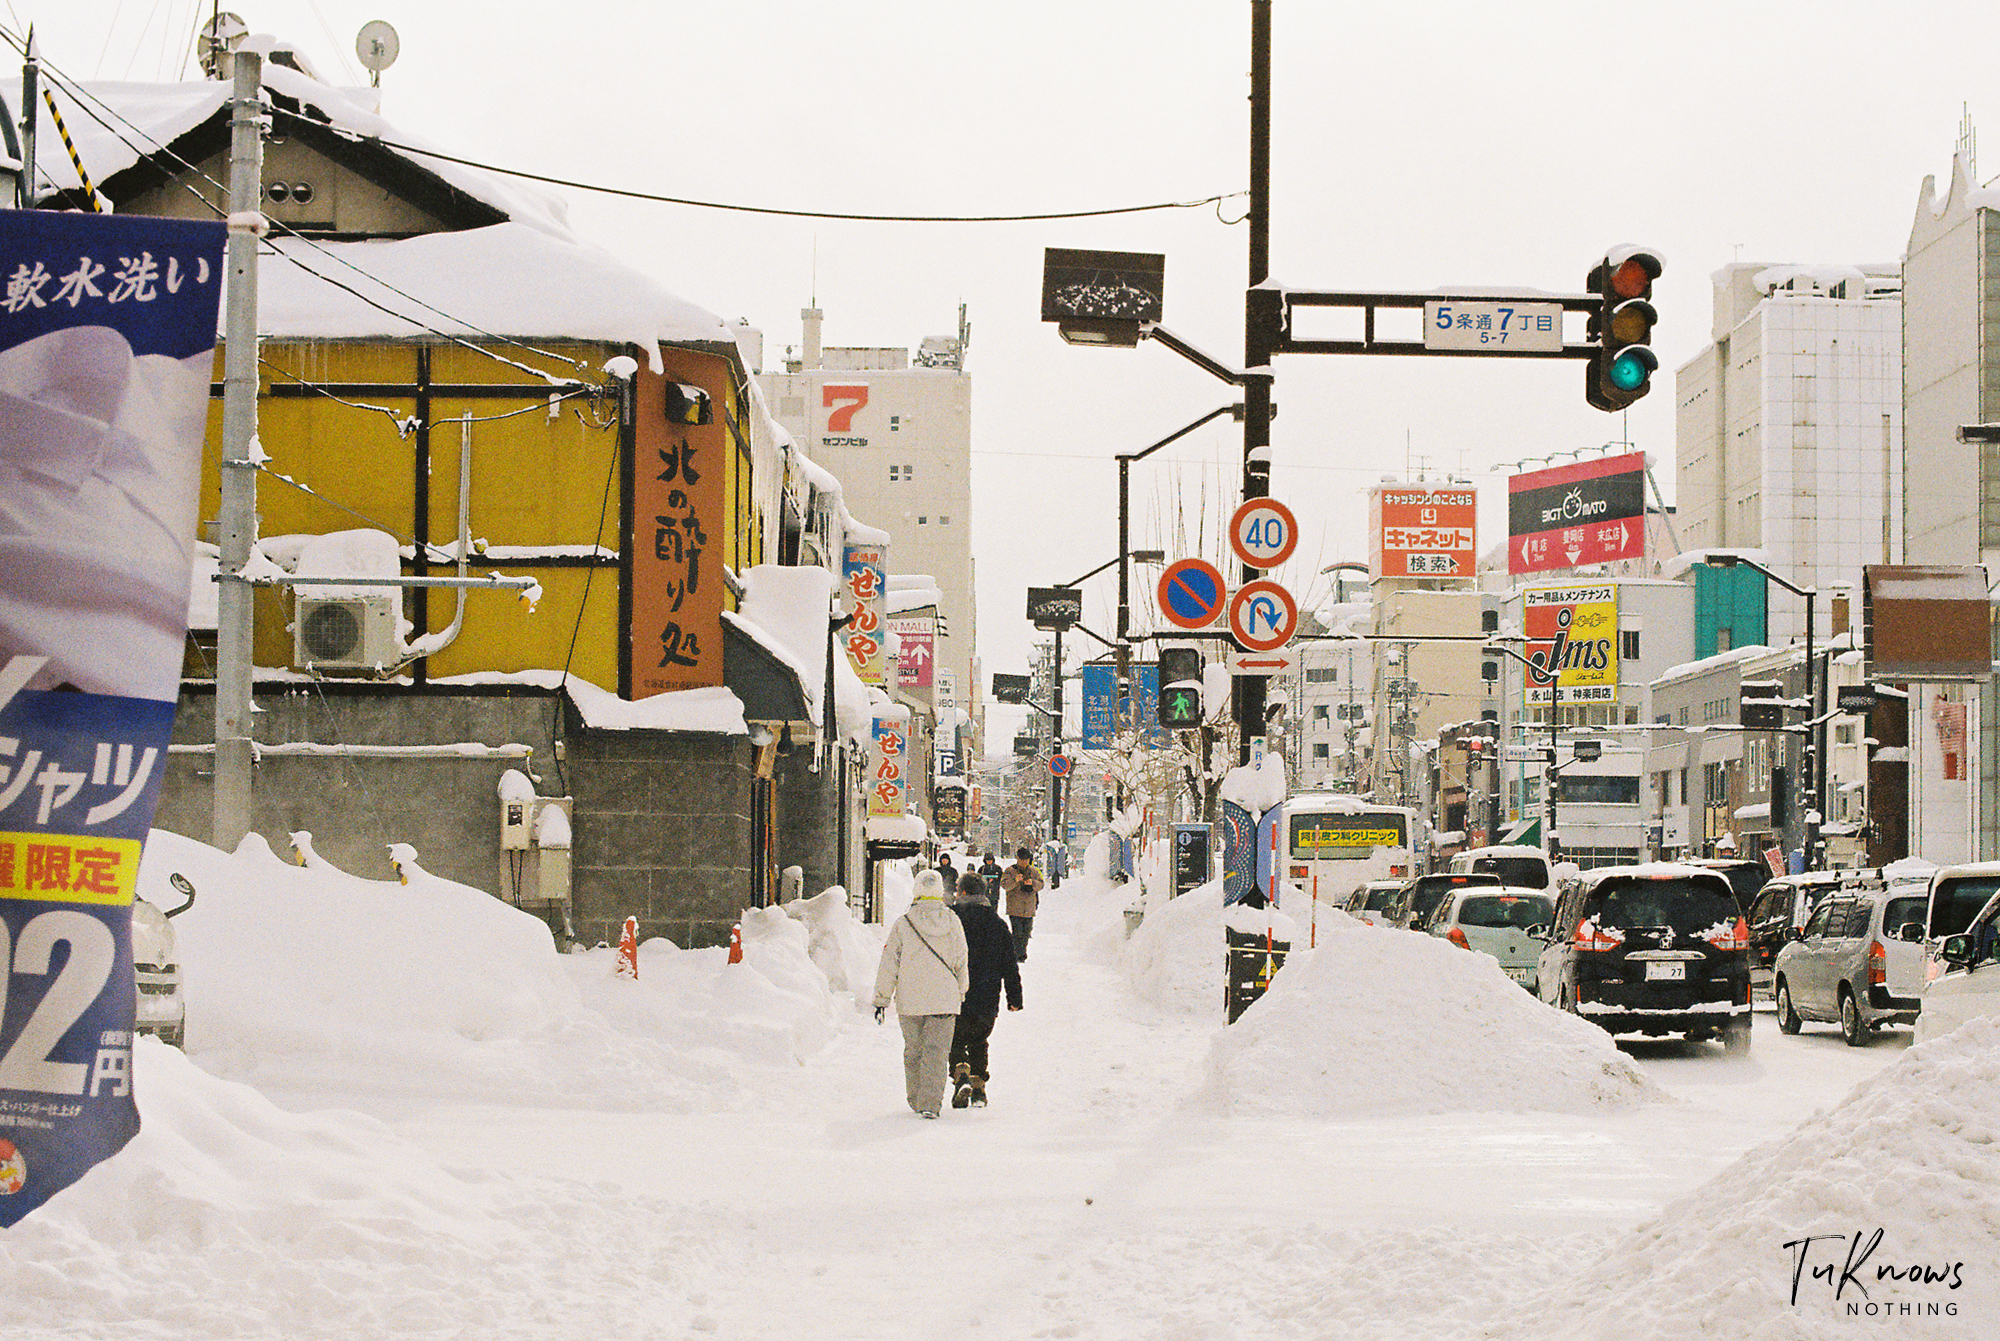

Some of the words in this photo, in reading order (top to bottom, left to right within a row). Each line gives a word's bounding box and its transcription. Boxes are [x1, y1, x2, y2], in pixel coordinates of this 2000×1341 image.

[0, 251, 210, 314] 軟水洗い
[1436, 307, 1552, 331] 5条通7丁目
[1480, 332, 1509, 344] 5-7
[822, 385, 869, 432] 7
[1246, 518, 1282, 548] 40
[1386, 529, 1471, 548] キャネット
[1410, 555, 1447, 572] 検索
[847, 567, 881, 666] せんや
[875, 731, 902, 805] せんや
[0, 910, 116, 1095] 2
